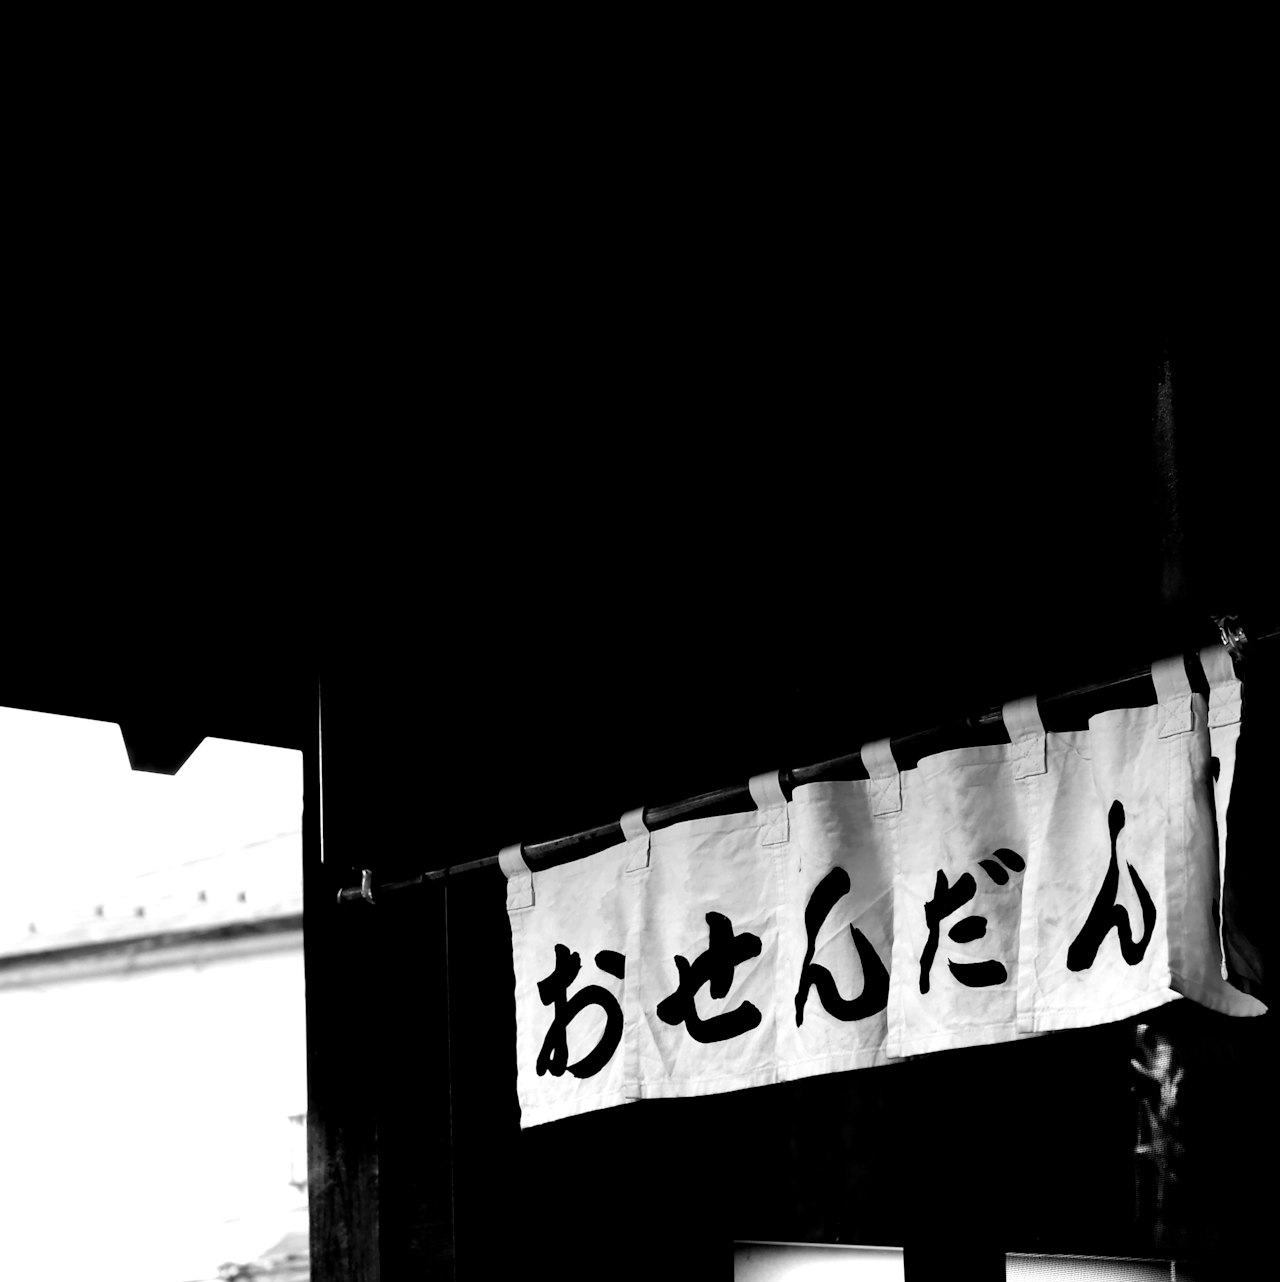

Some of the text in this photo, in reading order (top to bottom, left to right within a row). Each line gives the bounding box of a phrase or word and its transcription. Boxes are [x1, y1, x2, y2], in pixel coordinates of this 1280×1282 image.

[535, 799, 1157, 1079] おせんだん
